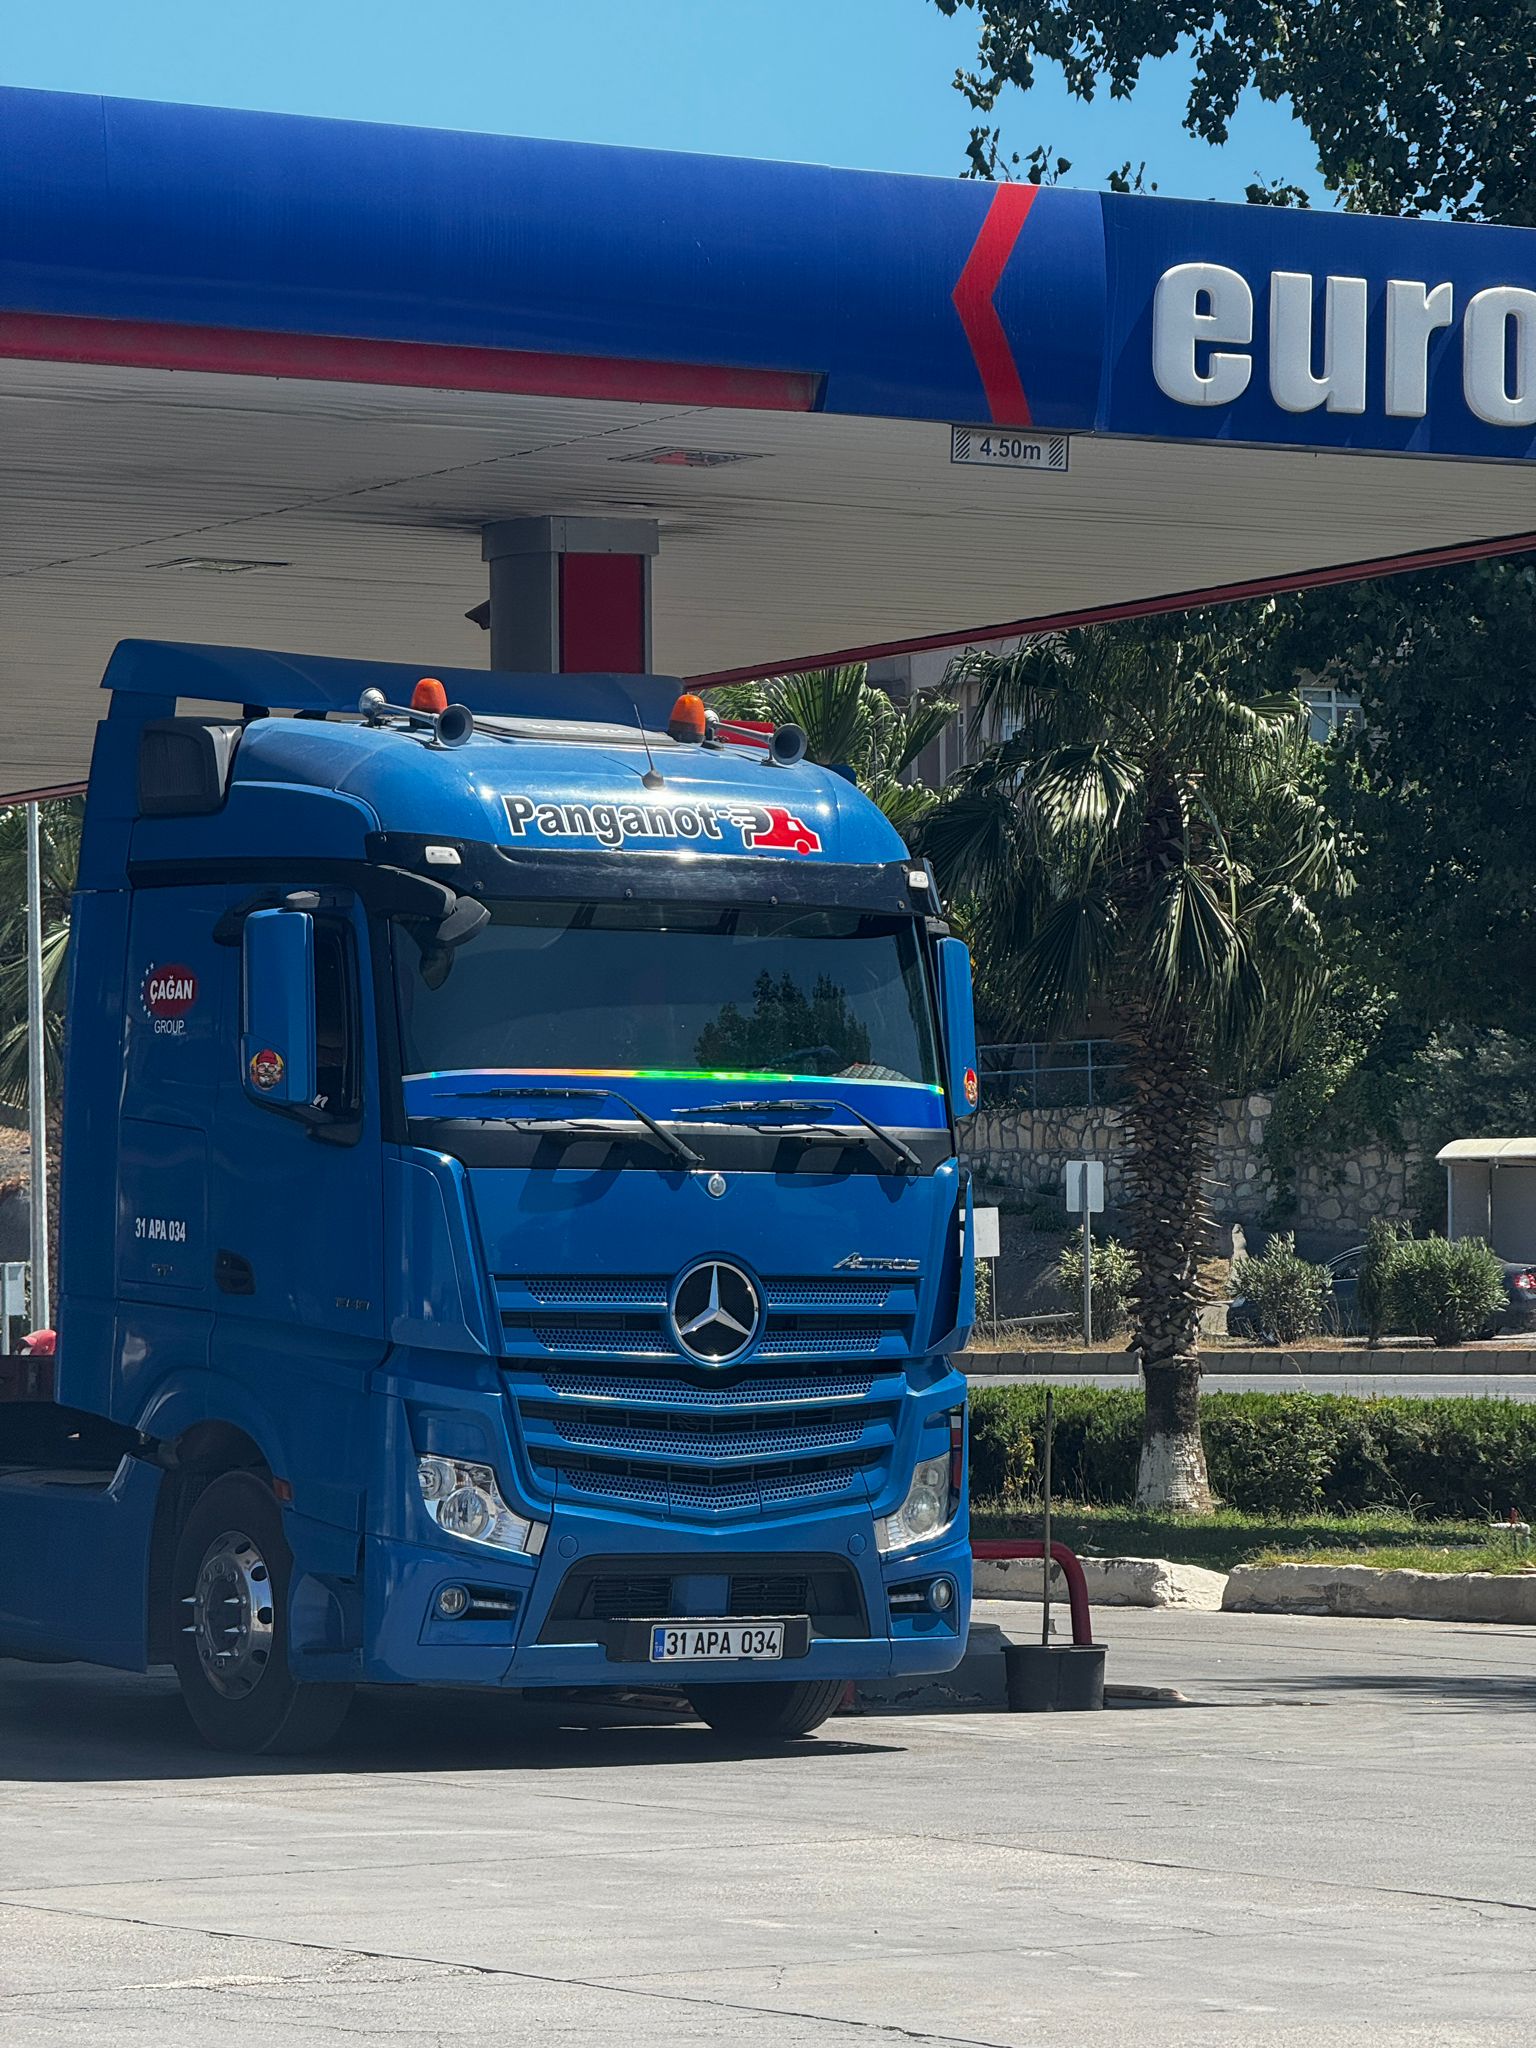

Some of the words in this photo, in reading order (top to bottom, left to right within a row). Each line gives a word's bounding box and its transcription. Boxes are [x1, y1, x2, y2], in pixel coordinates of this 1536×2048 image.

[1152, 262, 1536, 427] euro
[979, 437, 1041, 460] 4.50m
[501, 795, 723, 846] Panganot
[150, 975, 193, 1004] ÇAĞAN
[153, 1019, 185, 1034] GROUP
[135, 1217, 146, 1238] 31
[148, 1218, 167, 1240] APA
[168, 1220, 187, 1242] 034
[666, 1632, 688, 1655] 31
[693, 1631, 731, 1655] APA
[741, 1630, 777, 1654] 034
